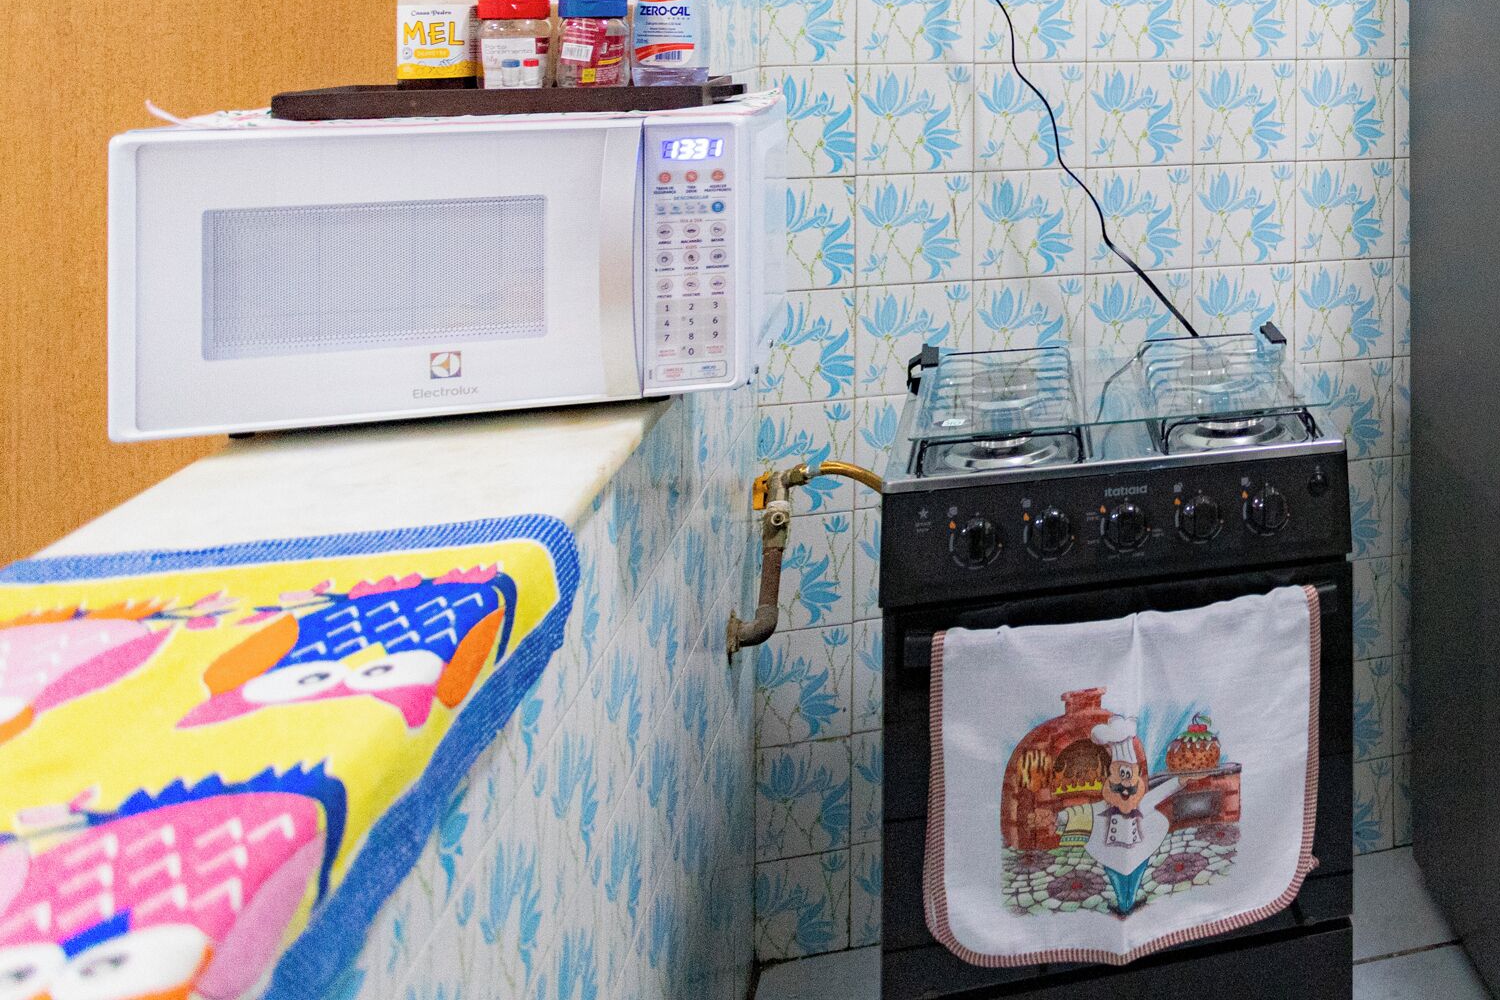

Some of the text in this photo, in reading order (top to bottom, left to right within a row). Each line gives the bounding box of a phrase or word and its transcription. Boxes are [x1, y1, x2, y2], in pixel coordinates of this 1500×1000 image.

[640, 5, 691, 16] ZERO-CAL
[403, 20, 465, 46] MEL
[713, 301, 718, 309] 3
[713, 316, 718, 324] 6
[688, 347, 694, 355] 0
[412, 385, 479, 399] Electrolux
